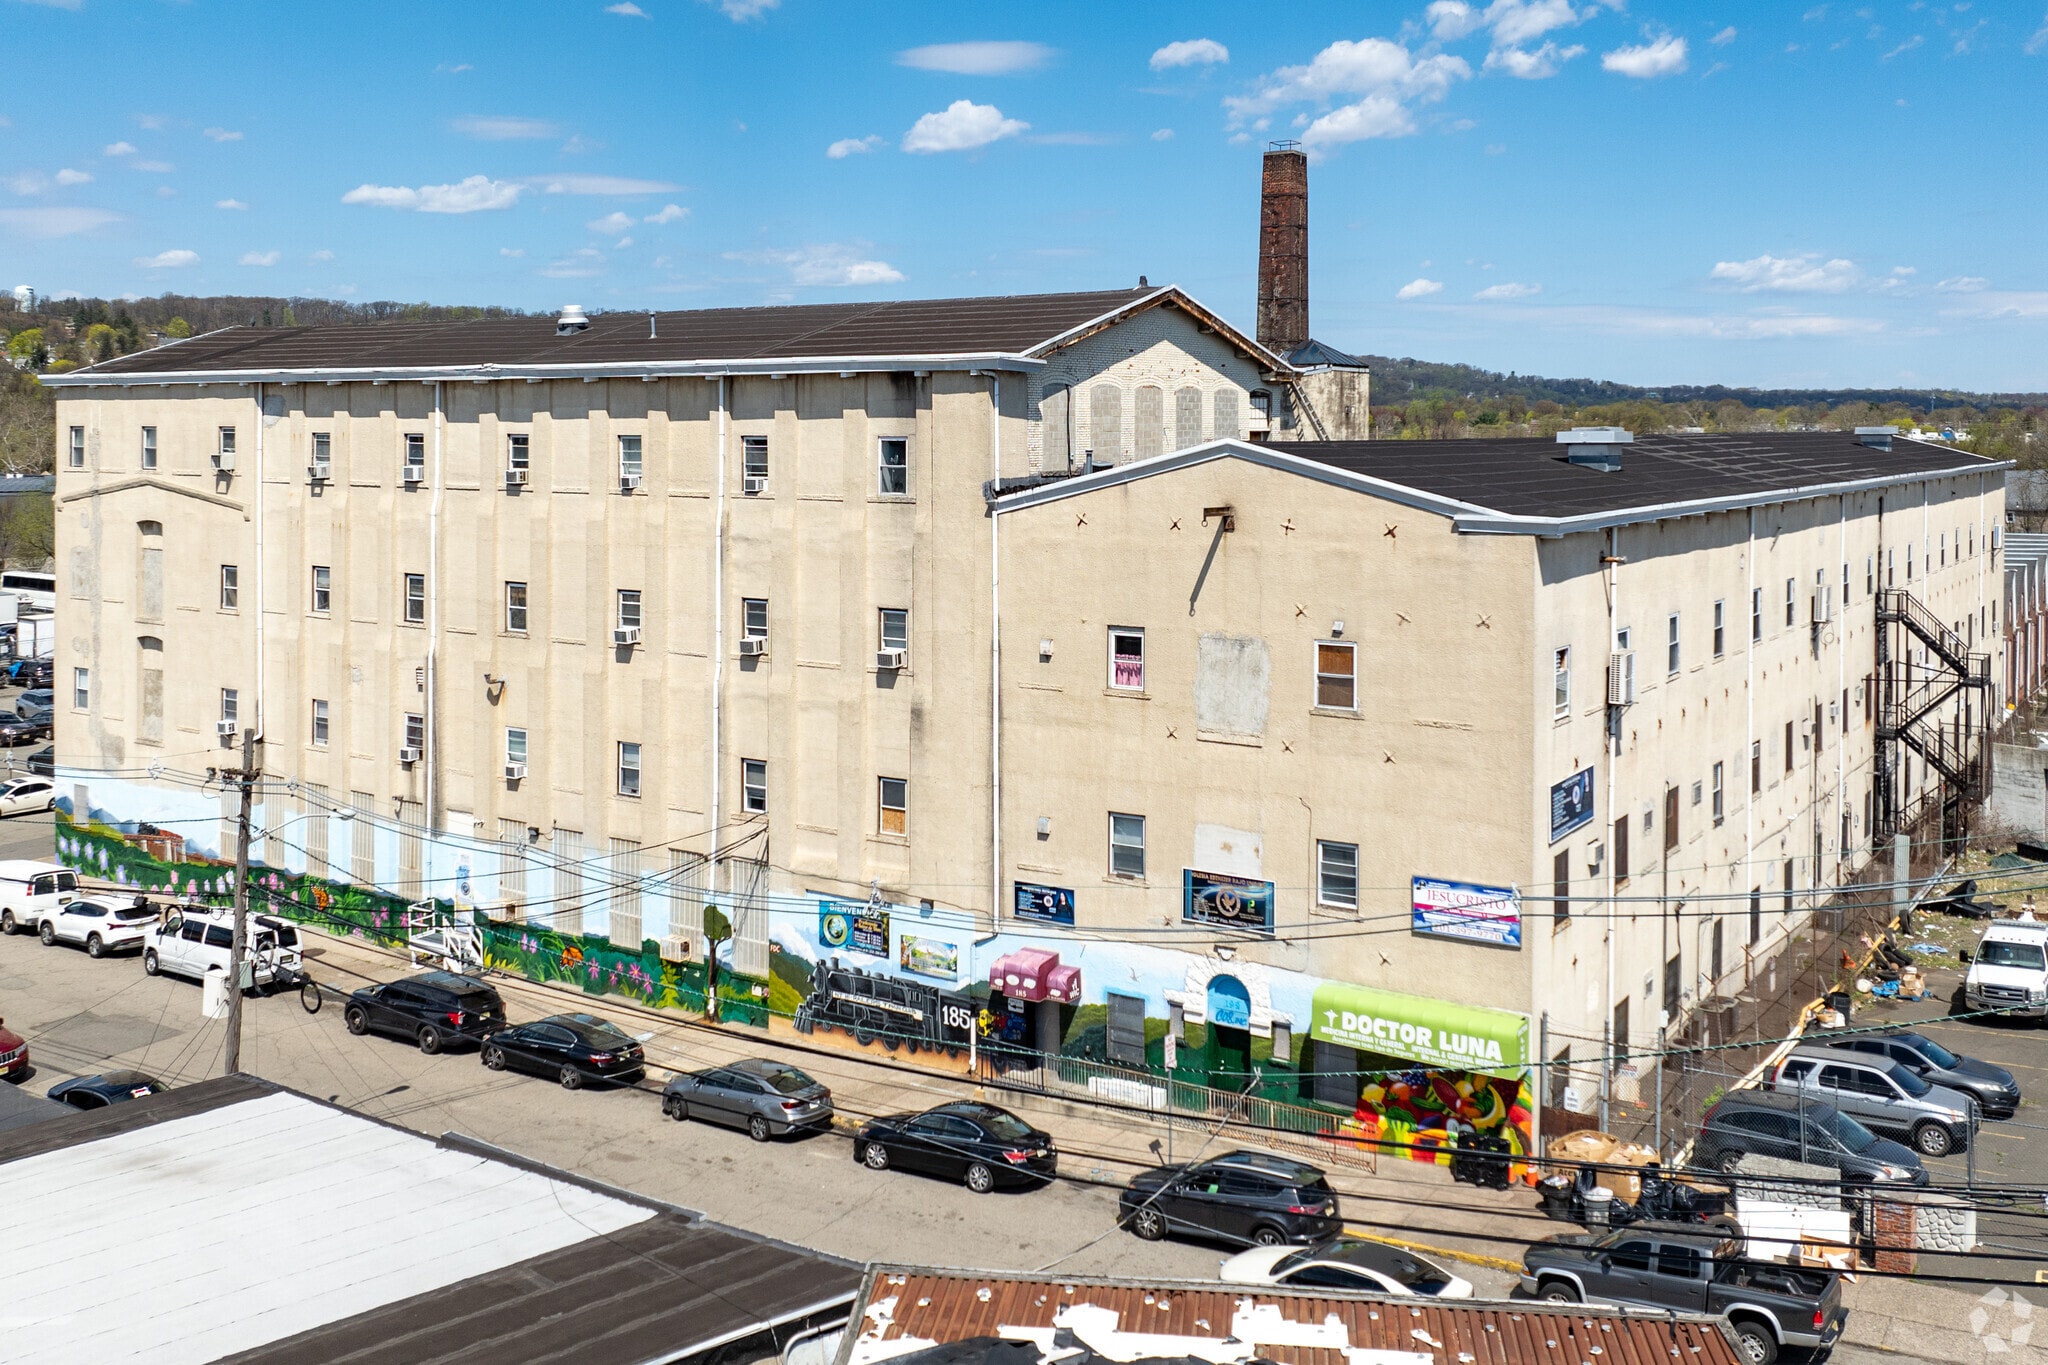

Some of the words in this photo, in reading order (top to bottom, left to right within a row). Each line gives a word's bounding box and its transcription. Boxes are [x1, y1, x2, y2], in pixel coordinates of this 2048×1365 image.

[1427, 889, 1506, 911] JESUCRISTO
[942, 1005, 971, 1029] 185
[1342, 1011, 1432, 1047] DOCTOR
[1439, 1030, 1502, 1062] LUNA
